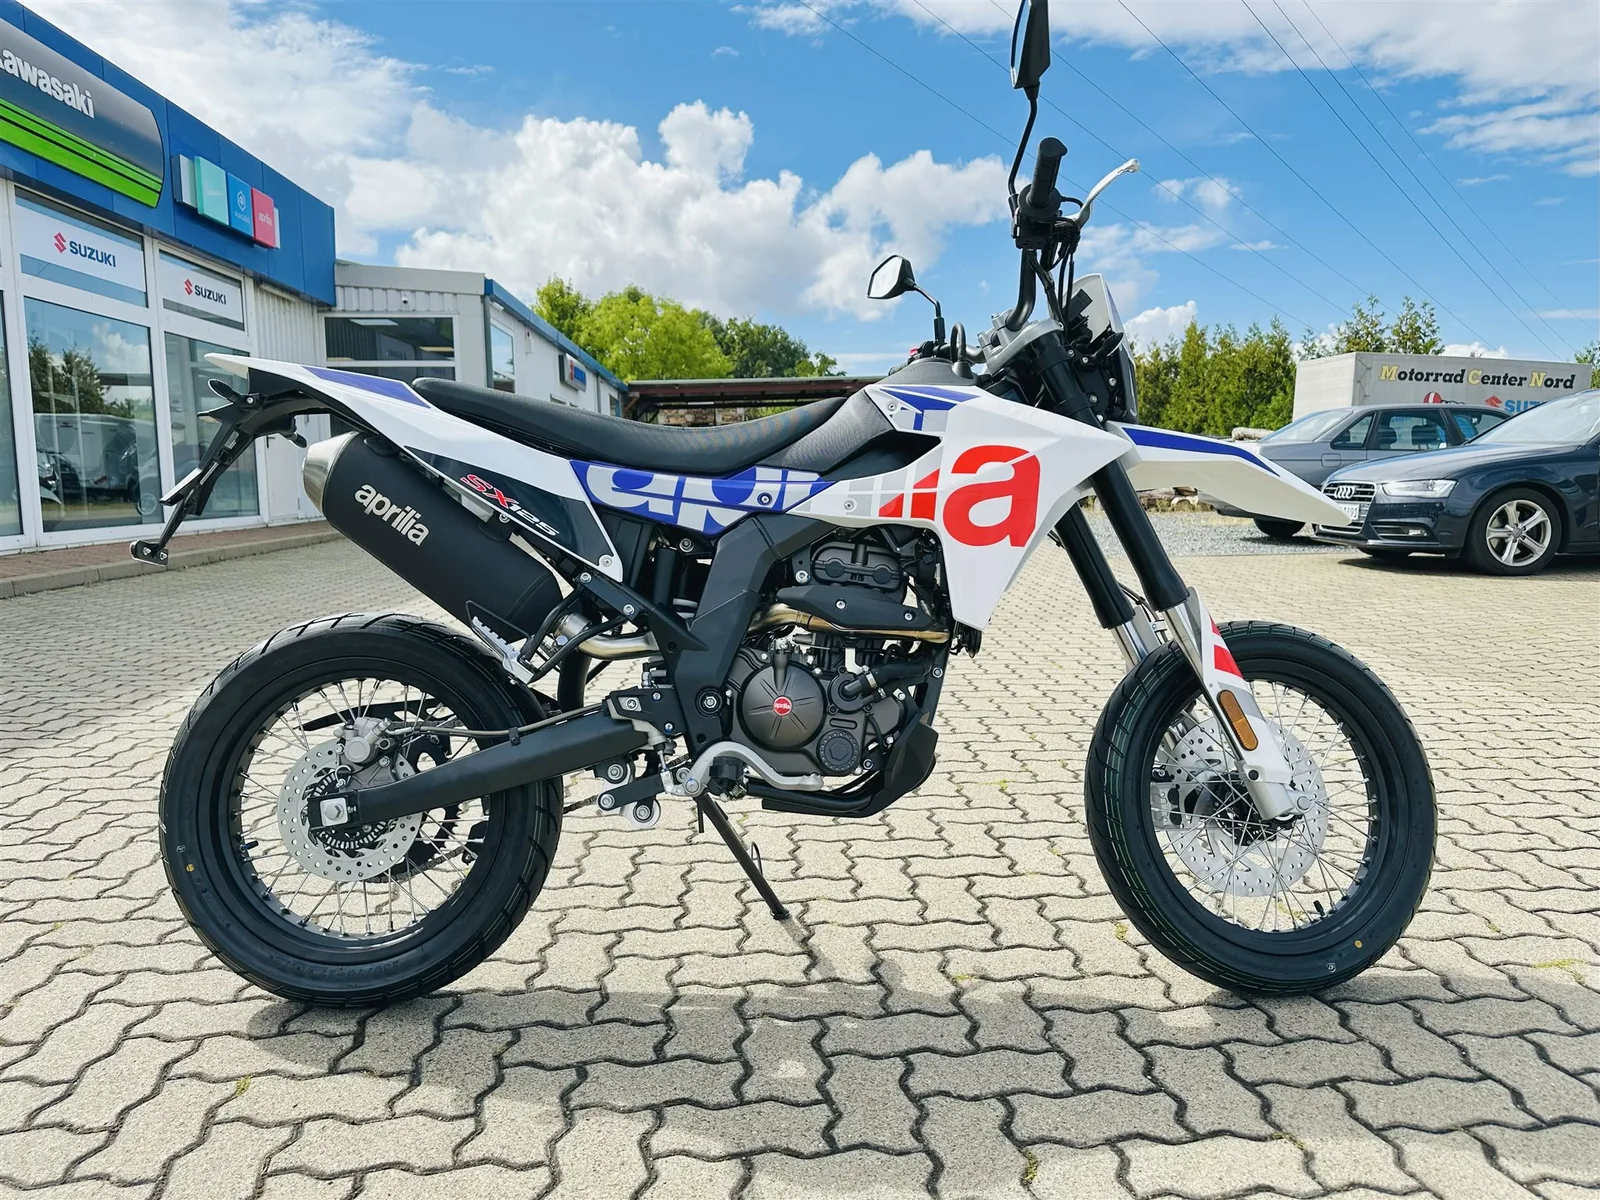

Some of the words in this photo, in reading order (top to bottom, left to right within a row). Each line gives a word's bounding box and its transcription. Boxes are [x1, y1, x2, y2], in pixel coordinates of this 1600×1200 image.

[69, 240, 116, 267] SUZUKI
[194, 284, 227, 305] SUZUKI
[1378, 364, 1466, 384] Motorrad
[1467, 368, 1528, 387] Center
[1529, 371, 1576, 389] Nord
[354, 484, 430, 546] aprilia
